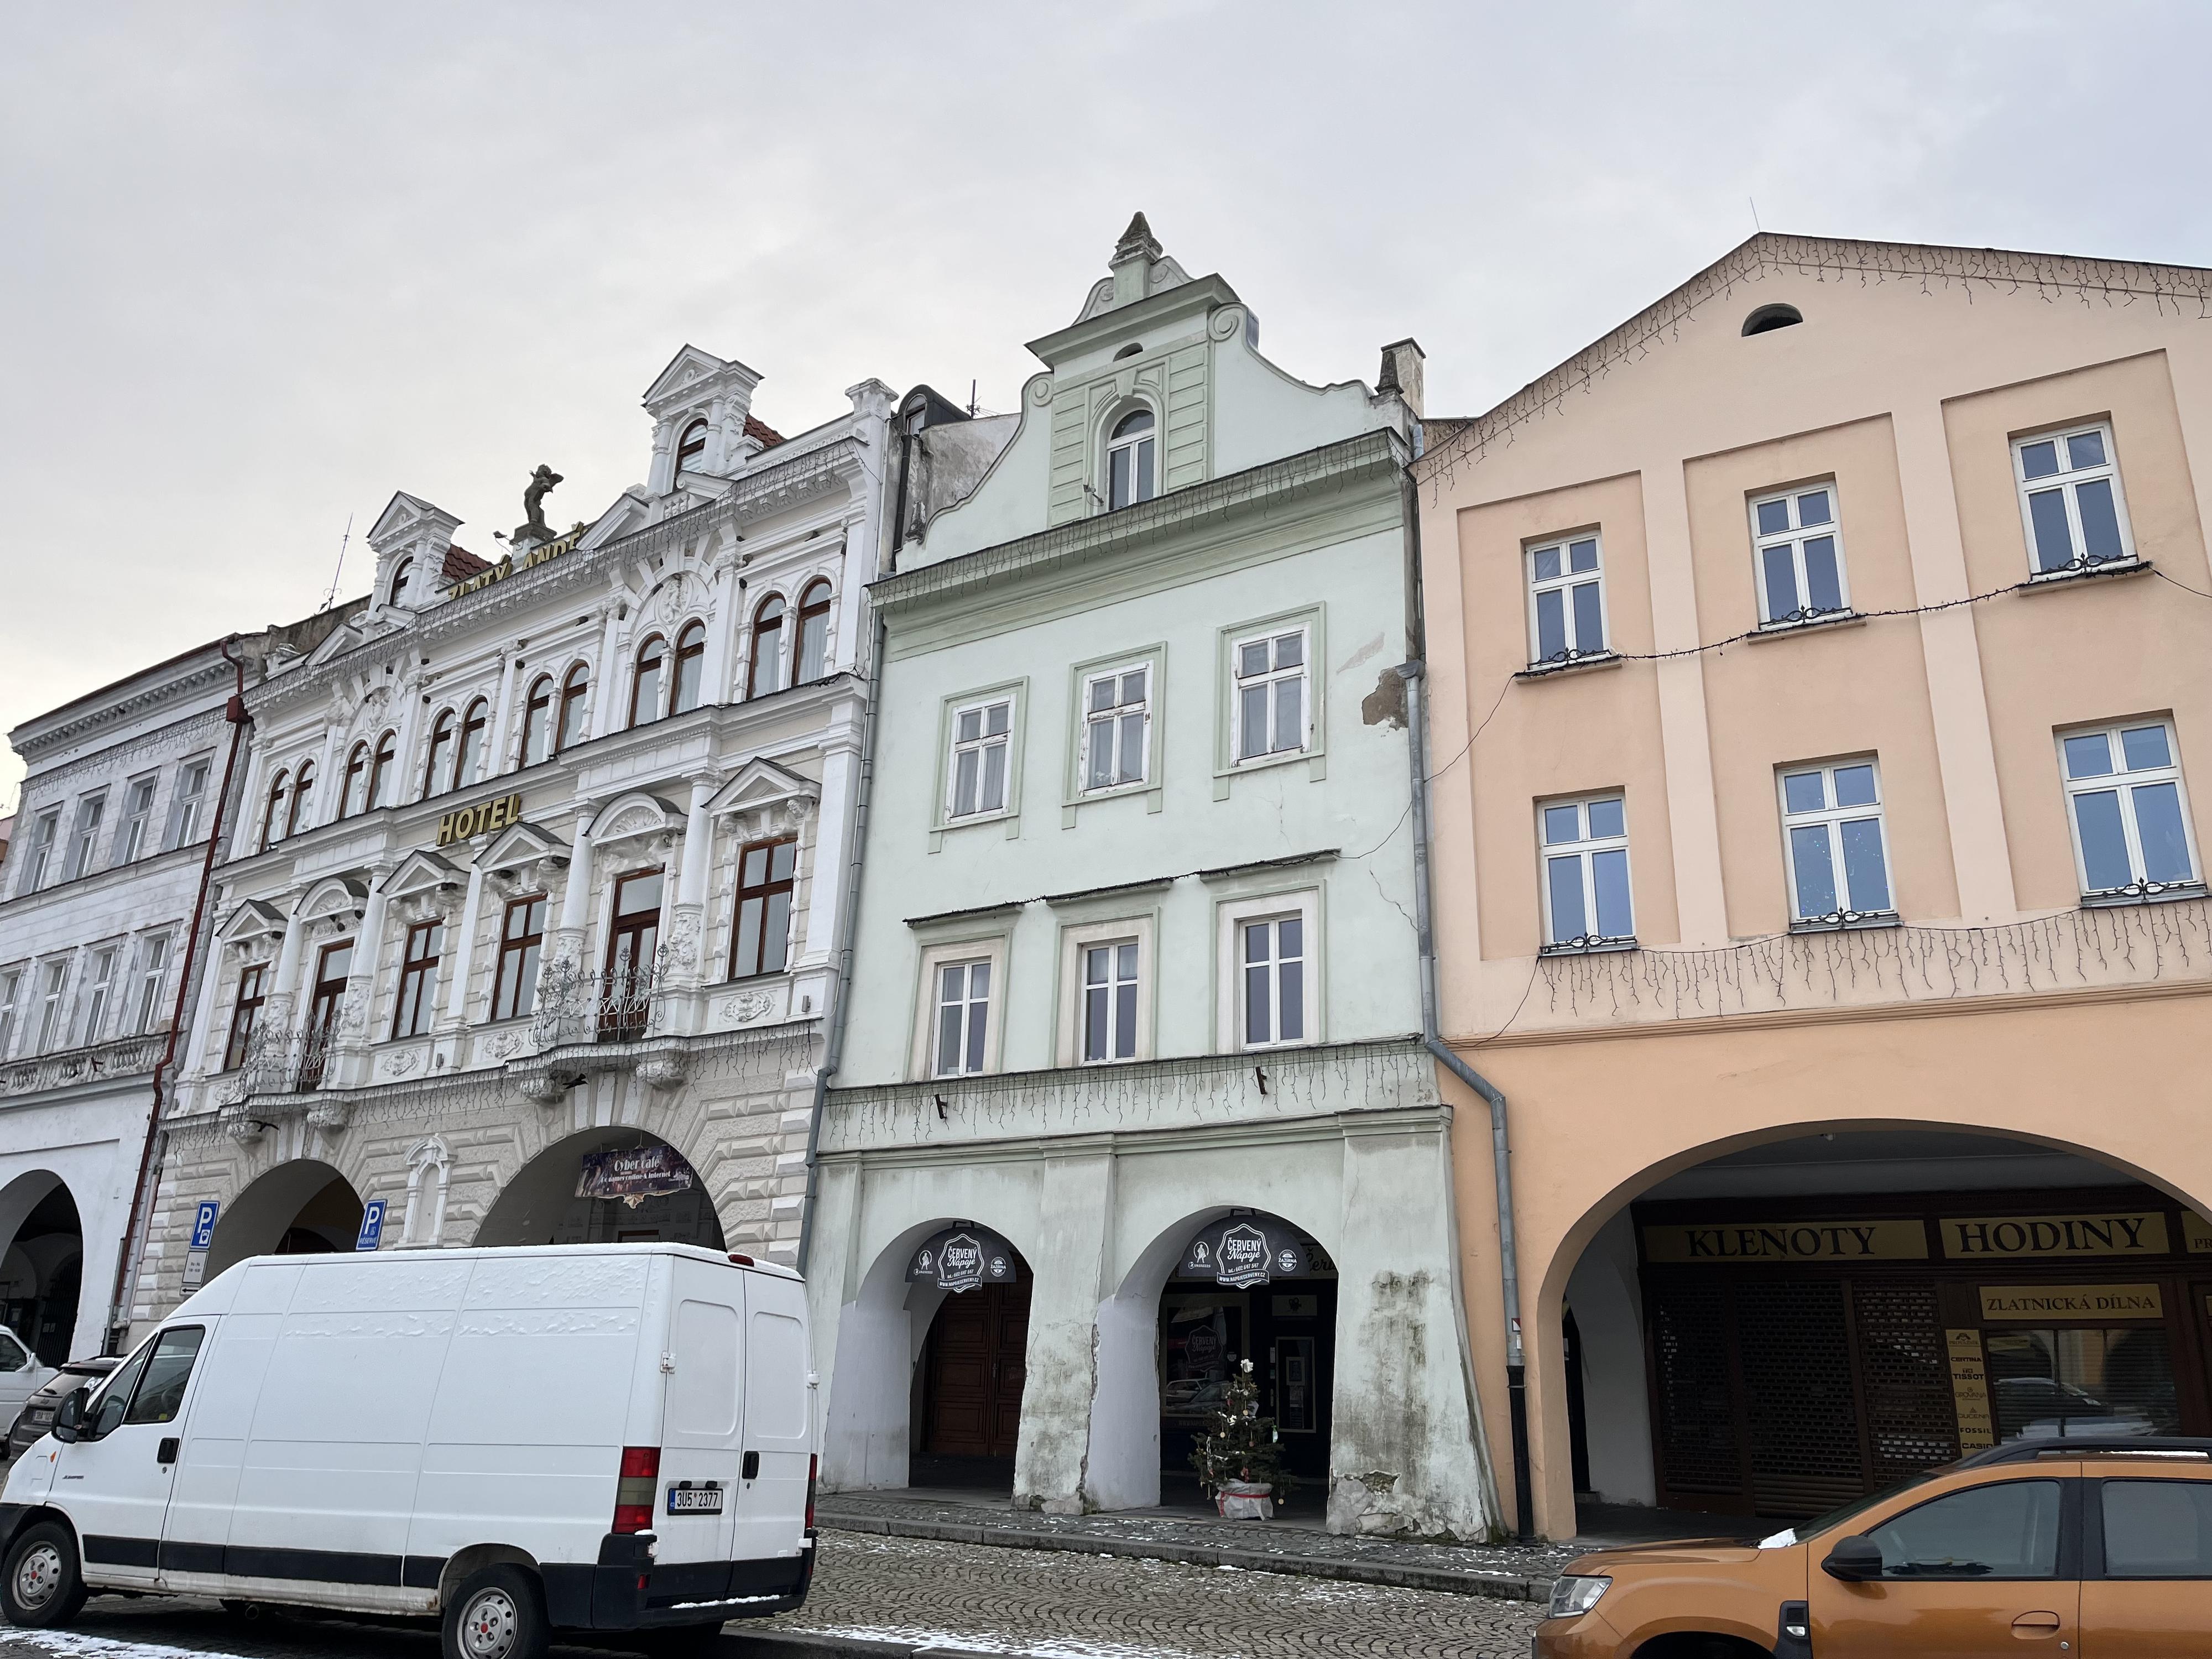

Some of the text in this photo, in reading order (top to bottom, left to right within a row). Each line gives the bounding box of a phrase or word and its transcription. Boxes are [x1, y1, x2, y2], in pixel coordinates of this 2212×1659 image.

[521, 521, 587, 571] ANDĚ
[436, 794, 521, 846] HOTEL
[614, 1158, 638, 1172] Cyber
[197, 1207, 212, 1233] P
[364, 1207, 380, 1234] P
[1228, 1237, 1261, 1251] ČERVENÝ
[1684, 1218, 2145, 1256] KLENOTY HODINY
[948, 1246, 977, 1259] ČERVENÝ
[1227, 1249, 1260, 1262] Nápoje
[947, 1257, 975, 1269] Nápoje
[1986, 1292, 2156, 1311] ZLATNICKÁ DÍLNA
[677, 1492, 718, 1507] 3U5 2377
